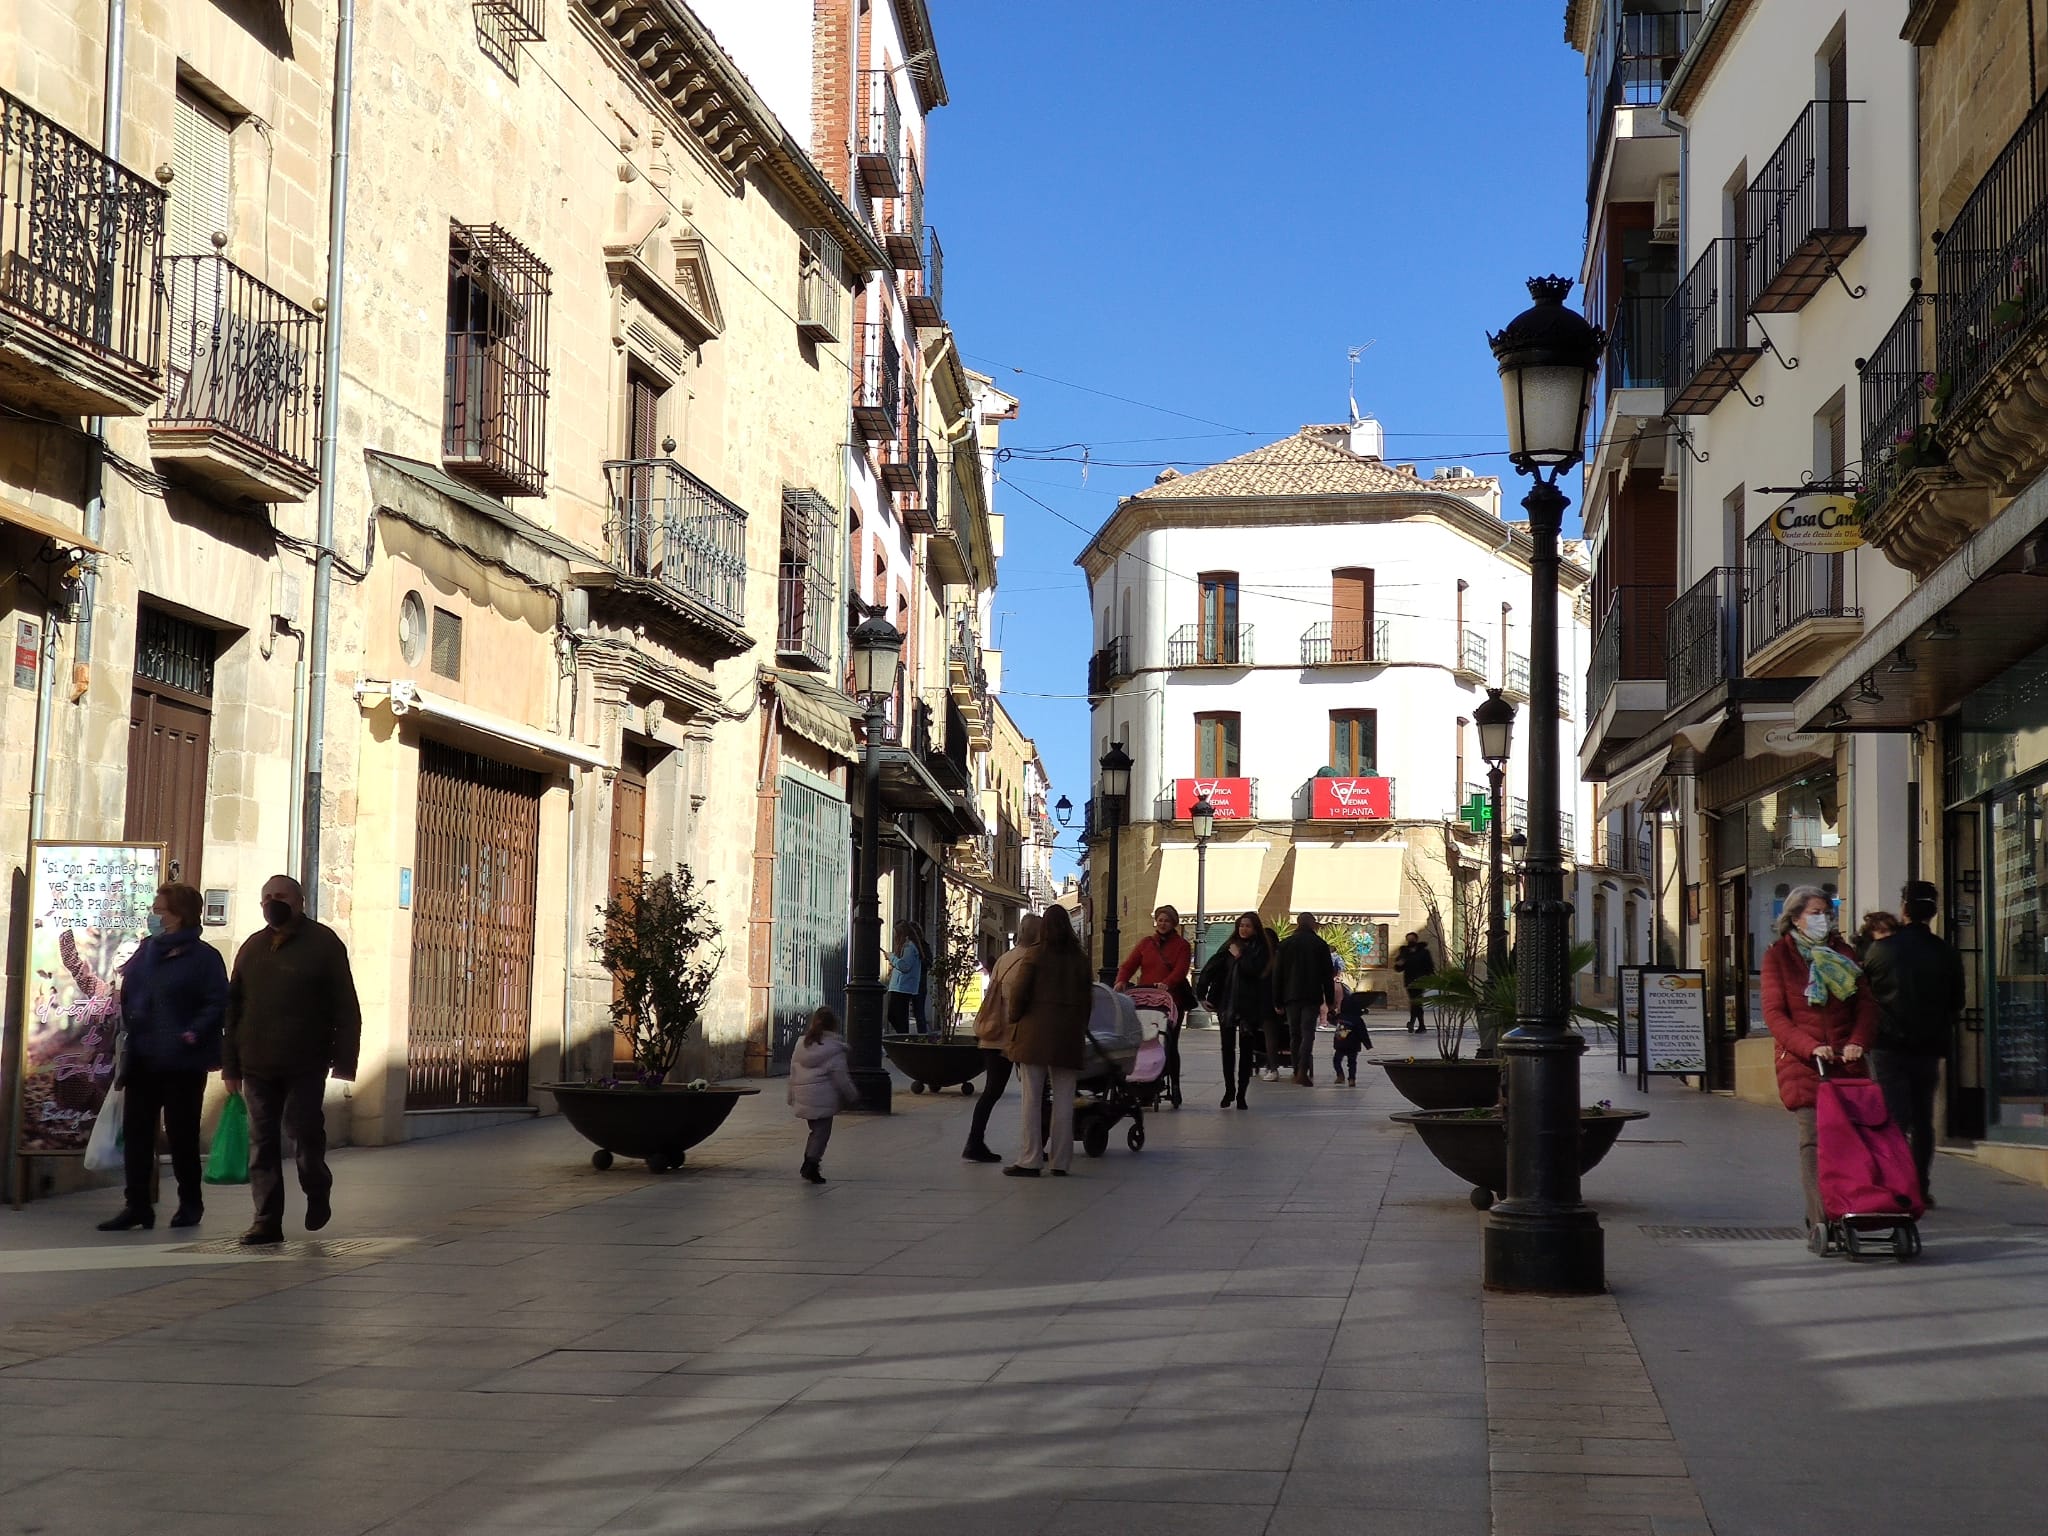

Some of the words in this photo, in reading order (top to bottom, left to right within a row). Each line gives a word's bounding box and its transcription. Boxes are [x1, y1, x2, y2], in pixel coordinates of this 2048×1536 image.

[1776, 506, 1817, 530] Casa
[1342, 808, 1375, 816] PLANTA
[63, 864, 83, 875] con
[52, 898, 84, 910] AMOR
[88, 898, 128, 911] PROPIO
